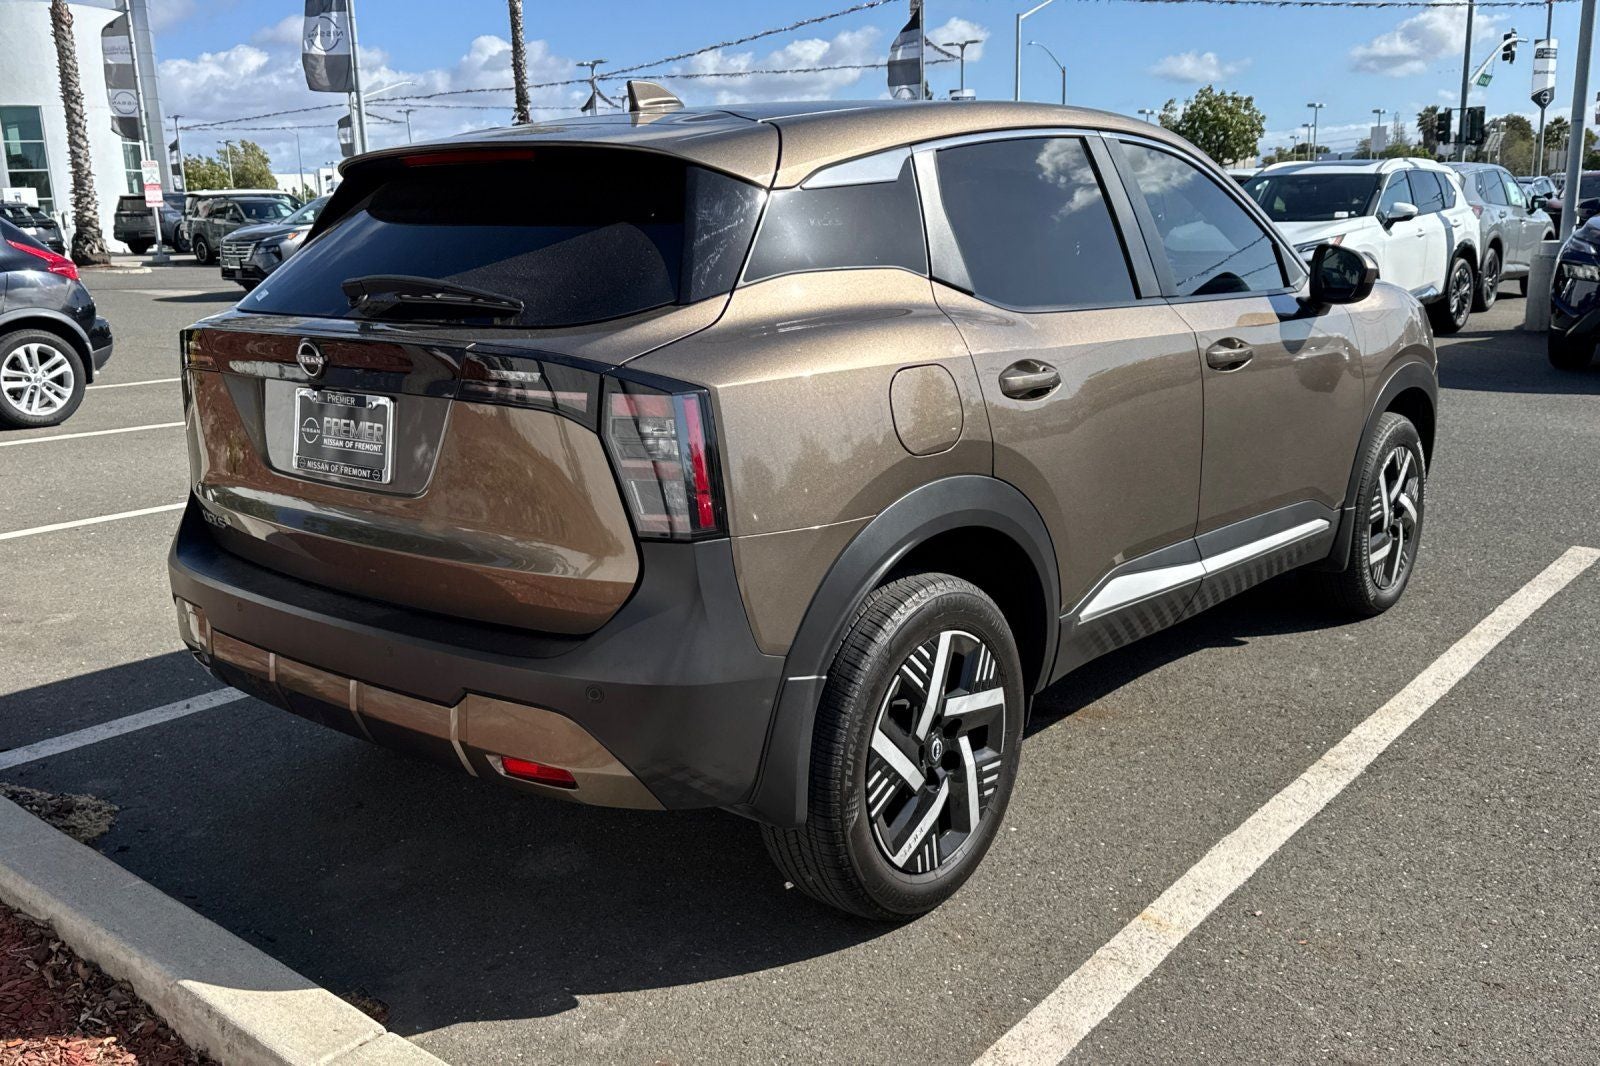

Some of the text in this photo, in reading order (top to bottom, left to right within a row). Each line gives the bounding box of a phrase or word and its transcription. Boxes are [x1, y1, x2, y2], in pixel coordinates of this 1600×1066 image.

[327, 393, 355, 405] PREMIER
[323, 416, 384, 442] PREMIER
[323, 438, 344, 447] NISSAN
[355, 442, 382, 452] FREMONT
[307, 460, 329, 471] NISSAN
[330, 463, 339, 472] OF
[340, 465, 371, 478] FREMONT
